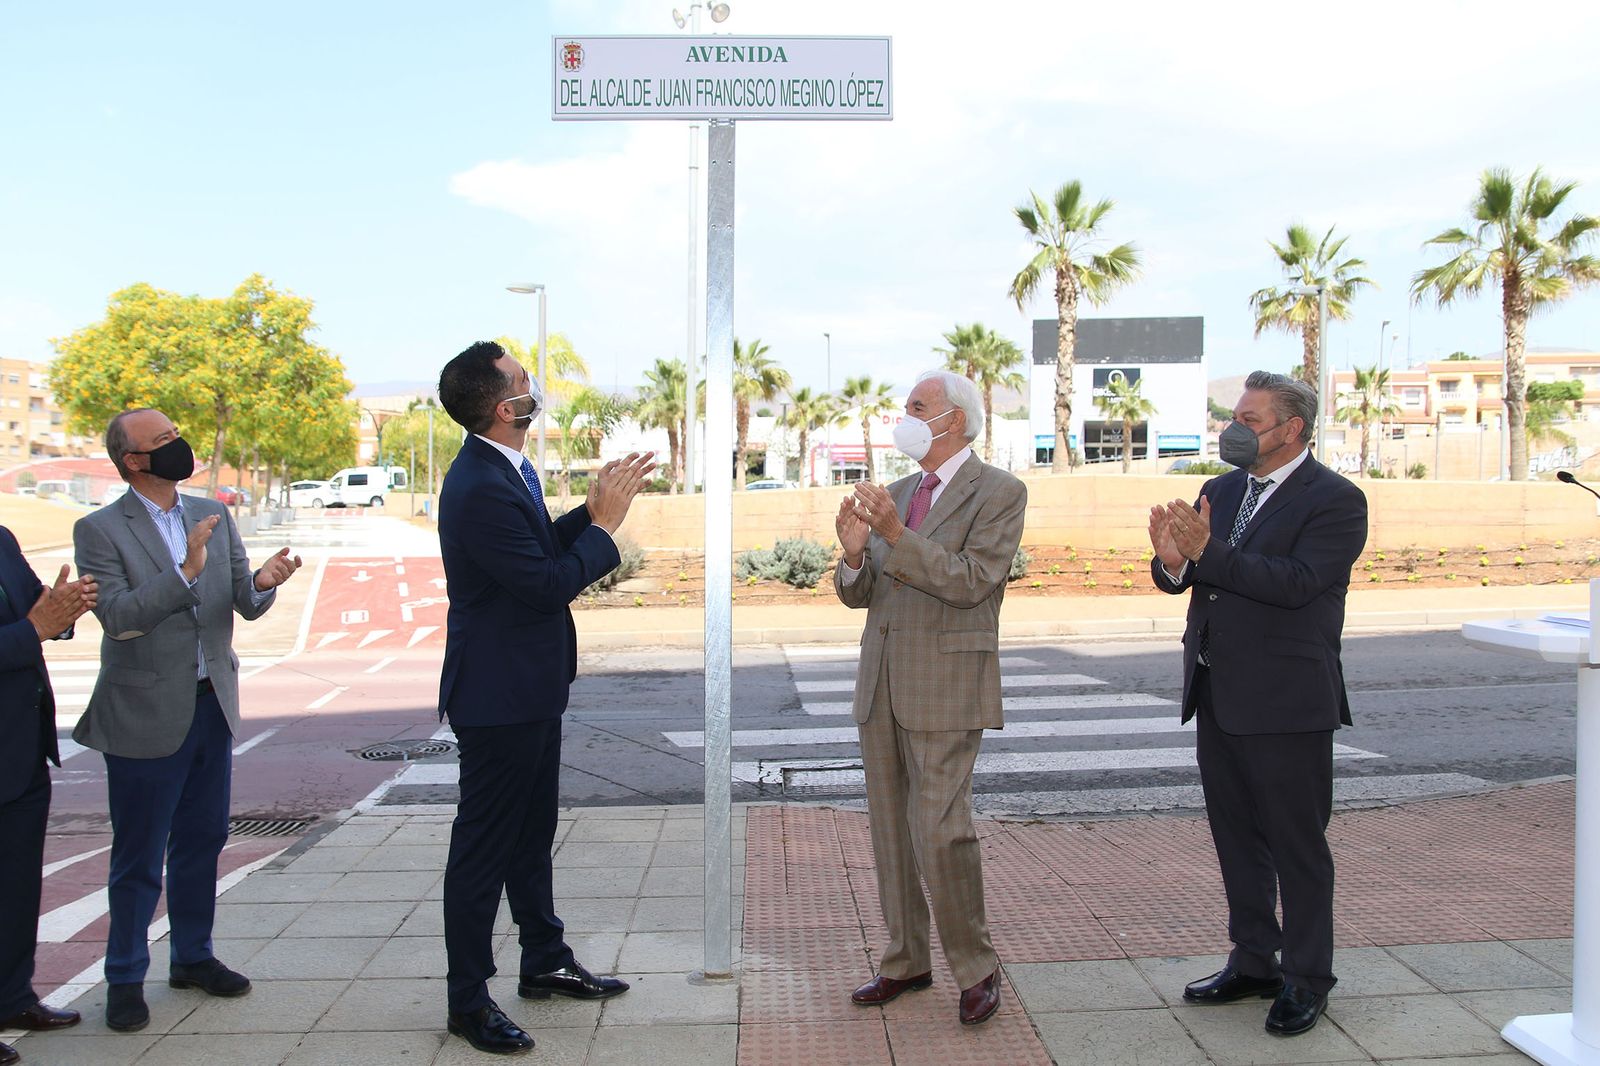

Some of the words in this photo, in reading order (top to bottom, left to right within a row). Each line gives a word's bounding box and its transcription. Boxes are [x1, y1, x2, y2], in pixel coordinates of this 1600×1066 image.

[685, 46, 788, 63] AVENIDA
[560, 79, 586, 107] DEL
[589, 79, 652, 107] ALCALDE
[655, 79, 692, 107] JUAN
[695, 79, 775, 107] FRANCISCO
[780, 79, 835, 107] MEGINO
[839, 71, 884, 108] LÓPEZ
